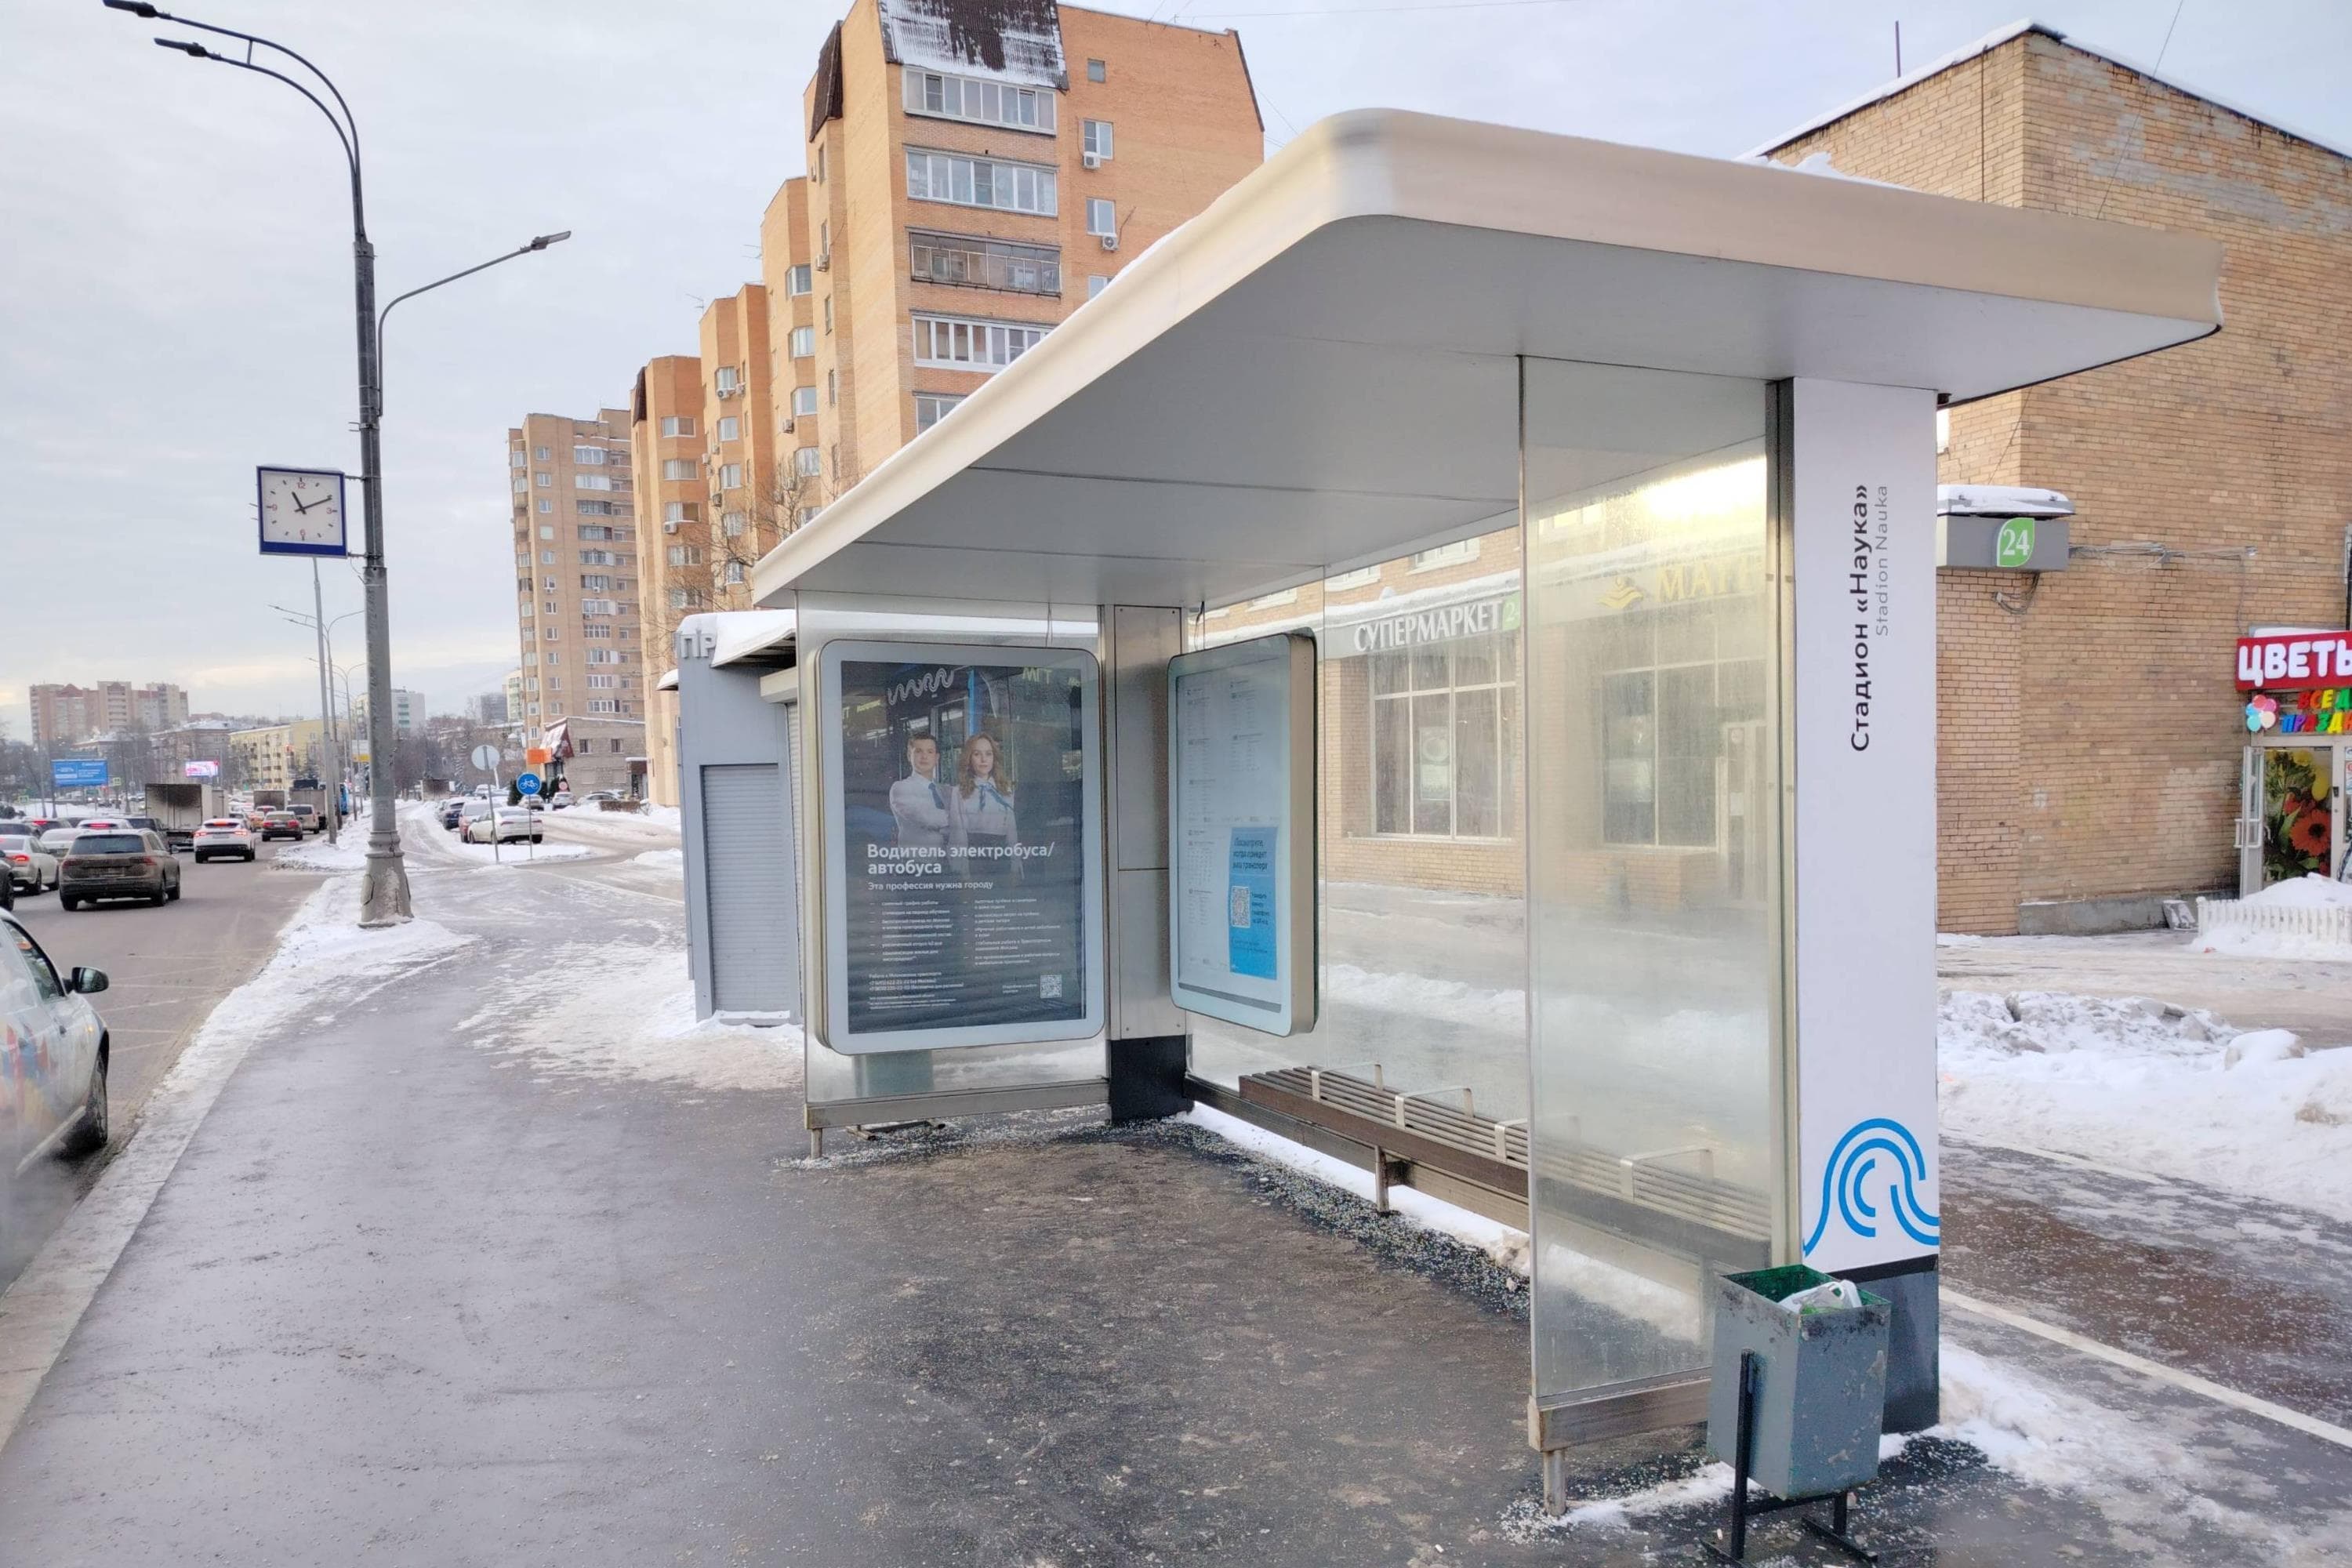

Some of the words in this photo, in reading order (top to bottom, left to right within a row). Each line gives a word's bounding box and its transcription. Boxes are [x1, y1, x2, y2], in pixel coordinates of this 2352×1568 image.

[1875, 485, 1888, 551] Nauka
[1849, 485, 1872, 613] «Наука»
[2002, 529, 2031, 556] 24
[1875, 559, 1889, 637] Stadion
[1354, 600, 1502, 652] СУПЕРМАРКЕТ
[1851, 623, 1871, 752] Стадион
[2297, 689, 2333, 710] ВСЕ
[868, 844, 946, 860] Водитель
[950, 842, 1055, 860] электробуса/
[868, 860, 942, 877] автобуса
[886, 881, 934, 891] профессия
[935, 881, 962, 891] нужна
[964, 881, 993, 890] городу
